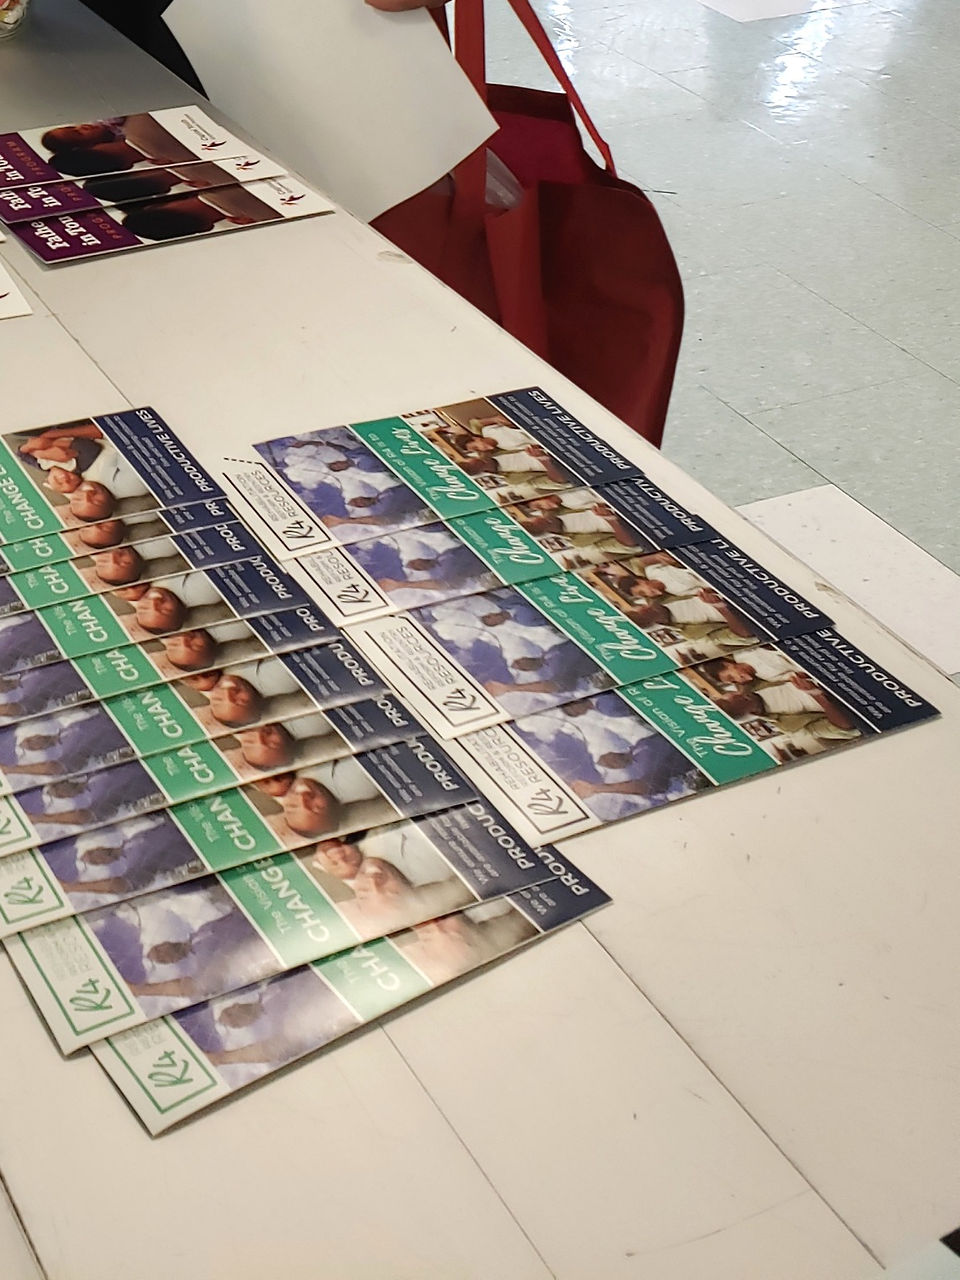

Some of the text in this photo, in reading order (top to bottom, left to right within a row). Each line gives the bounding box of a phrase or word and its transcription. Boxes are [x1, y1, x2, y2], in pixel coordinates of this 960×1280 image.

[6, 141, 44, 176] PROGRAM
[6, 170, 25, 181] in
[43, 200, 62, 208] in
[31, 220, 70, 250] Fathe
[58, 216, 102, 246] in Tou
[136, 409, 161, 434] LIVES
[528, 391, 560, 415] LIVES
[155, 433, 214, 493] PRODUCTIVE
[557, 413, 631, 470] PRODUCTIVE
[392, 427, 480, 500] Change Lives
[251, 470, 298, 517] RESOURCES
[632, 477, 704, 532] PRODUCTIV
[282, 520, 315, 539] R4
[484, 516, 544, 564] Change
[39, 566, 69, 594] CHA
[249, 556, 293, 599] PRODU
[337, 583, 371, 603] R4
[724, 548, 820, 619] PRODUCTIVE
[68, 599, 108, 643] CHAN
[550, 574, 657, 661] Change Live
[106, 649, 139, 682] CHA
[328, 642, 374, 686] PRODU
[396, 626, 457, 685] RESOURCES
[816, 628, 923, 708] PRODUCTIVE
[140, 689, 183, 739] CHAN
[442, 688, 481, 712] R4
[636, 697, 653, 708] of
[838, 683, 868, 705] ensure
[867, 706, 883, 718] We
[875, 702, 892, 713] are
[652, 707, 686, 738] Vision
[674, 694, 753, 756] Change
[177, 747, 214, 784] CHA
[411, 740, 461, 791] PRODU
[483, 728, 542, 783] RESOURC
[209, 795, 256, 850] CHAN
[527, 788, 568, 815] R4
[467, 802, 535, 870] PRODUC
[3, 876, 44, 905] R4
[536, 848, 589, 897] PRODU
[243, 875, 291, 934] The Vision
[253, 857, 330, 942] CHANGE
[350, 946, 401, 992] CHA
[69, 977, 113, 1012] R4
[147, 1050, 194, 1088] R4
